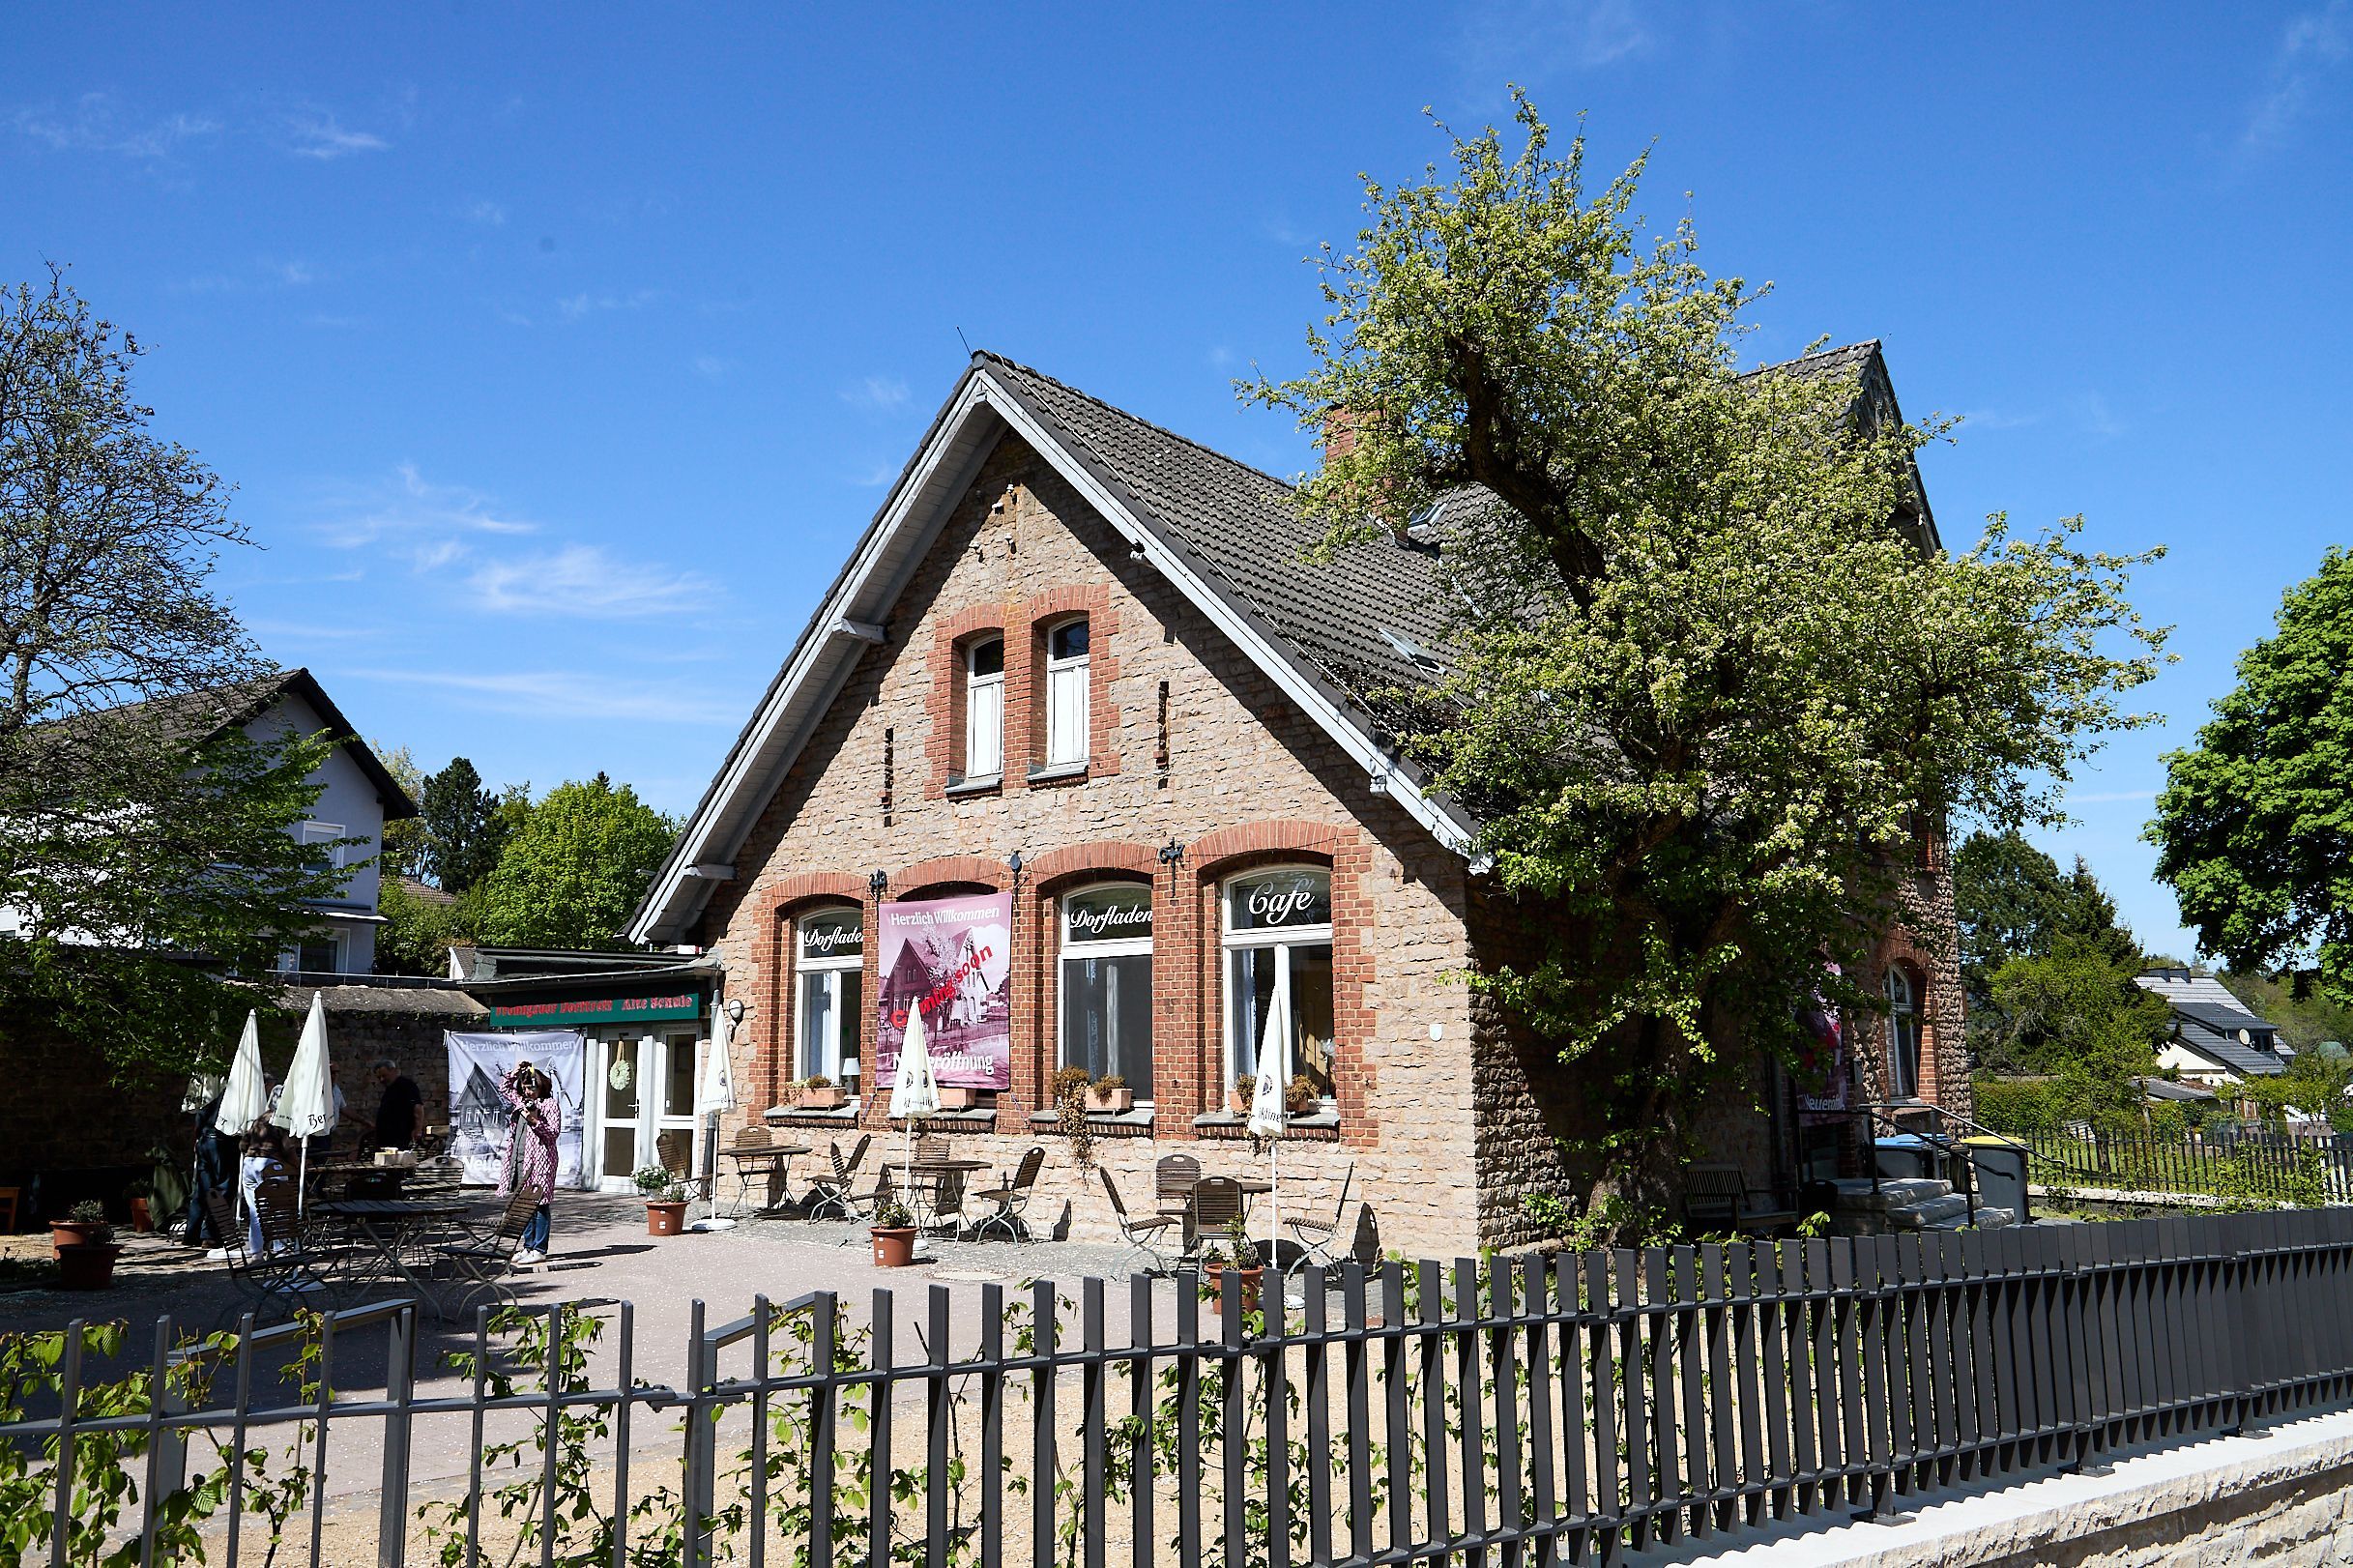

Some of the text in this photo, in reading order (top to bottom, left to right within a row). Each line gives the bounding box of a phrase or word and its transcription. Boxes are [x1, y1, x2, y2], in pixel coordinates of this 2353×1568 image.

[1249, 878, 1316, 924] Café
[890, 907, 1000, 926] Herzlich Willkommen
[1070, 904, 1152, 934] Dorfladen
[890, 945, 993, 1028] Cming soon
[461, 1039, 576, 1053] Herzlich Willkommen
